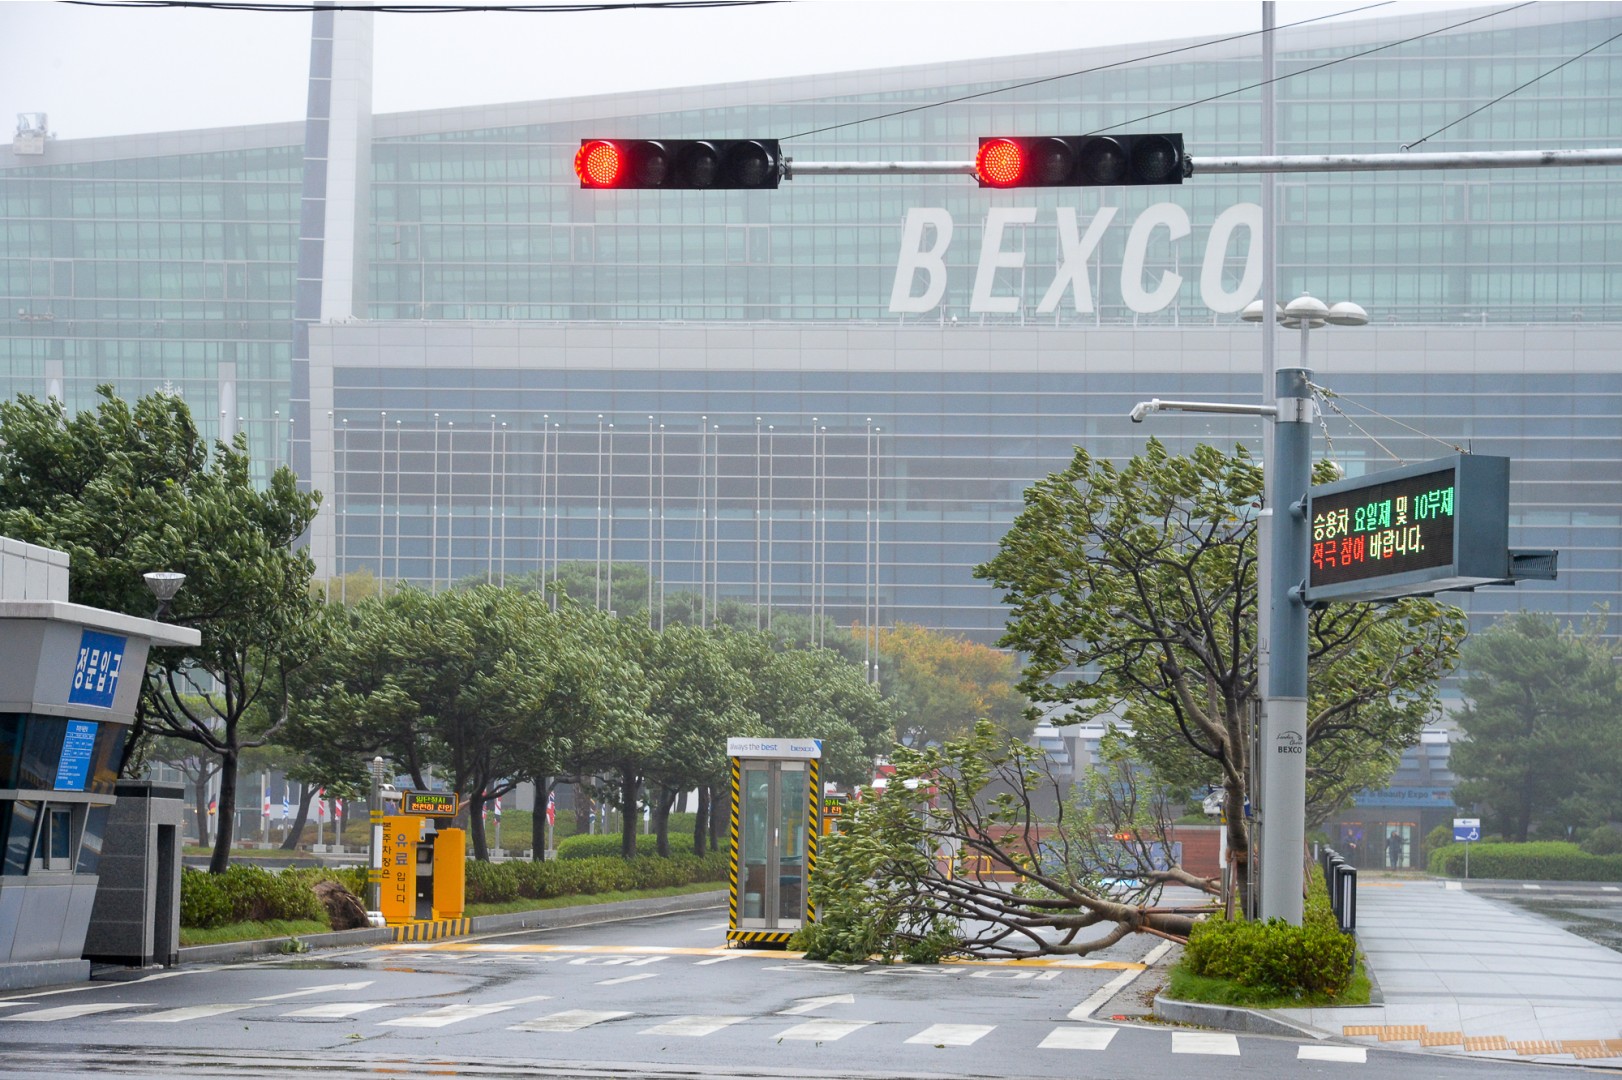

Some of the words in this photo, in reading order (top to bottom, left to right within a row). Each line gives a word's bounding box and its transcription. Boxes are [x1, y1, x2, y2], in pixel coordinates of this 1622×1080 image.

[889, 203, 1264, 314] BEXCO
[1313, 507, 1349, 541] 승용차
[1354, 499, 1391, 532] 요일제
[1396, 496, 1408, 526] 및
[1414, 486, 1454, 520] 10부제
[1312, 542, 1337, 570] 적극
[1341, 535, 1365, 566] 참여
[1370, 524, 1425, 560] 바랍니다.
[74, 647, 122, 694] 정문입구
[748, 743, 760, 751] the
[1277, 746, 1303, 754] BEXCO
[1407, 789, 1429, 799] Expo
